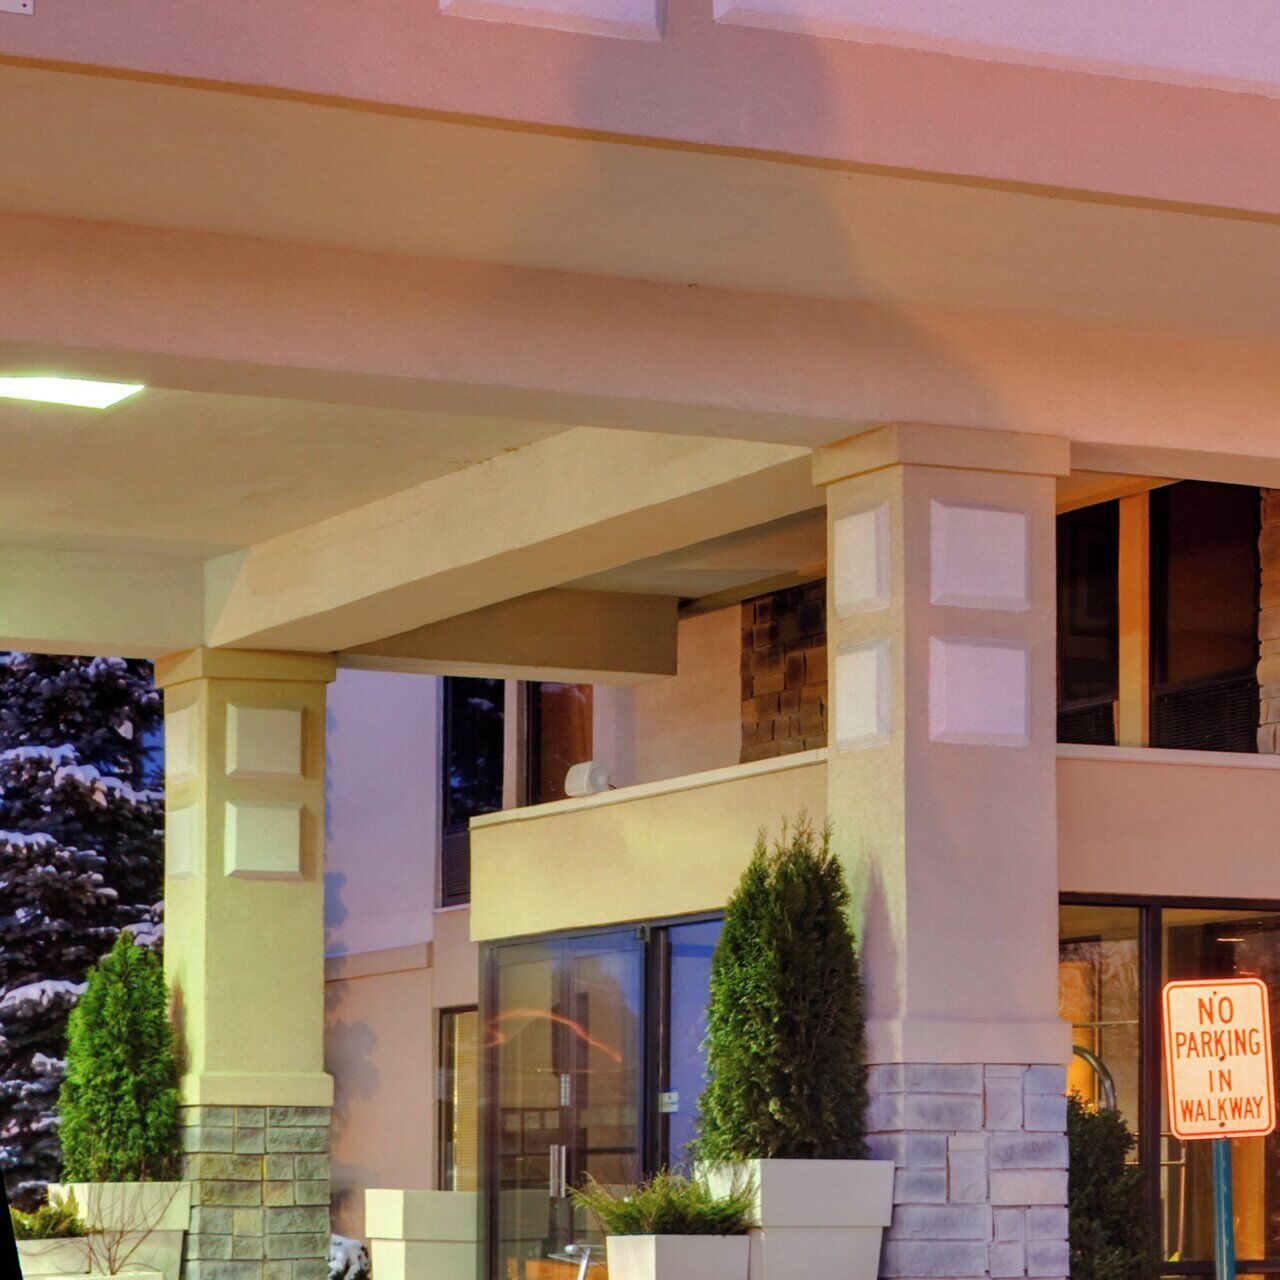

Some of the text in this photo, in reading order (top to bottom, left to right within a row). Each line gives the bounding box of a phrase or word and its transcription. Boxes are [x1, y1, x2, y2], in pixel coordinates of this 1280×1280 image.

[1197, 996, 1234, 1025] NO
[1175, 1028, 1261, 1059] PARKING
[1209, 1068, 1233, 1092] IN
[1180, 1095, 1264, 1123] WALKWAY
